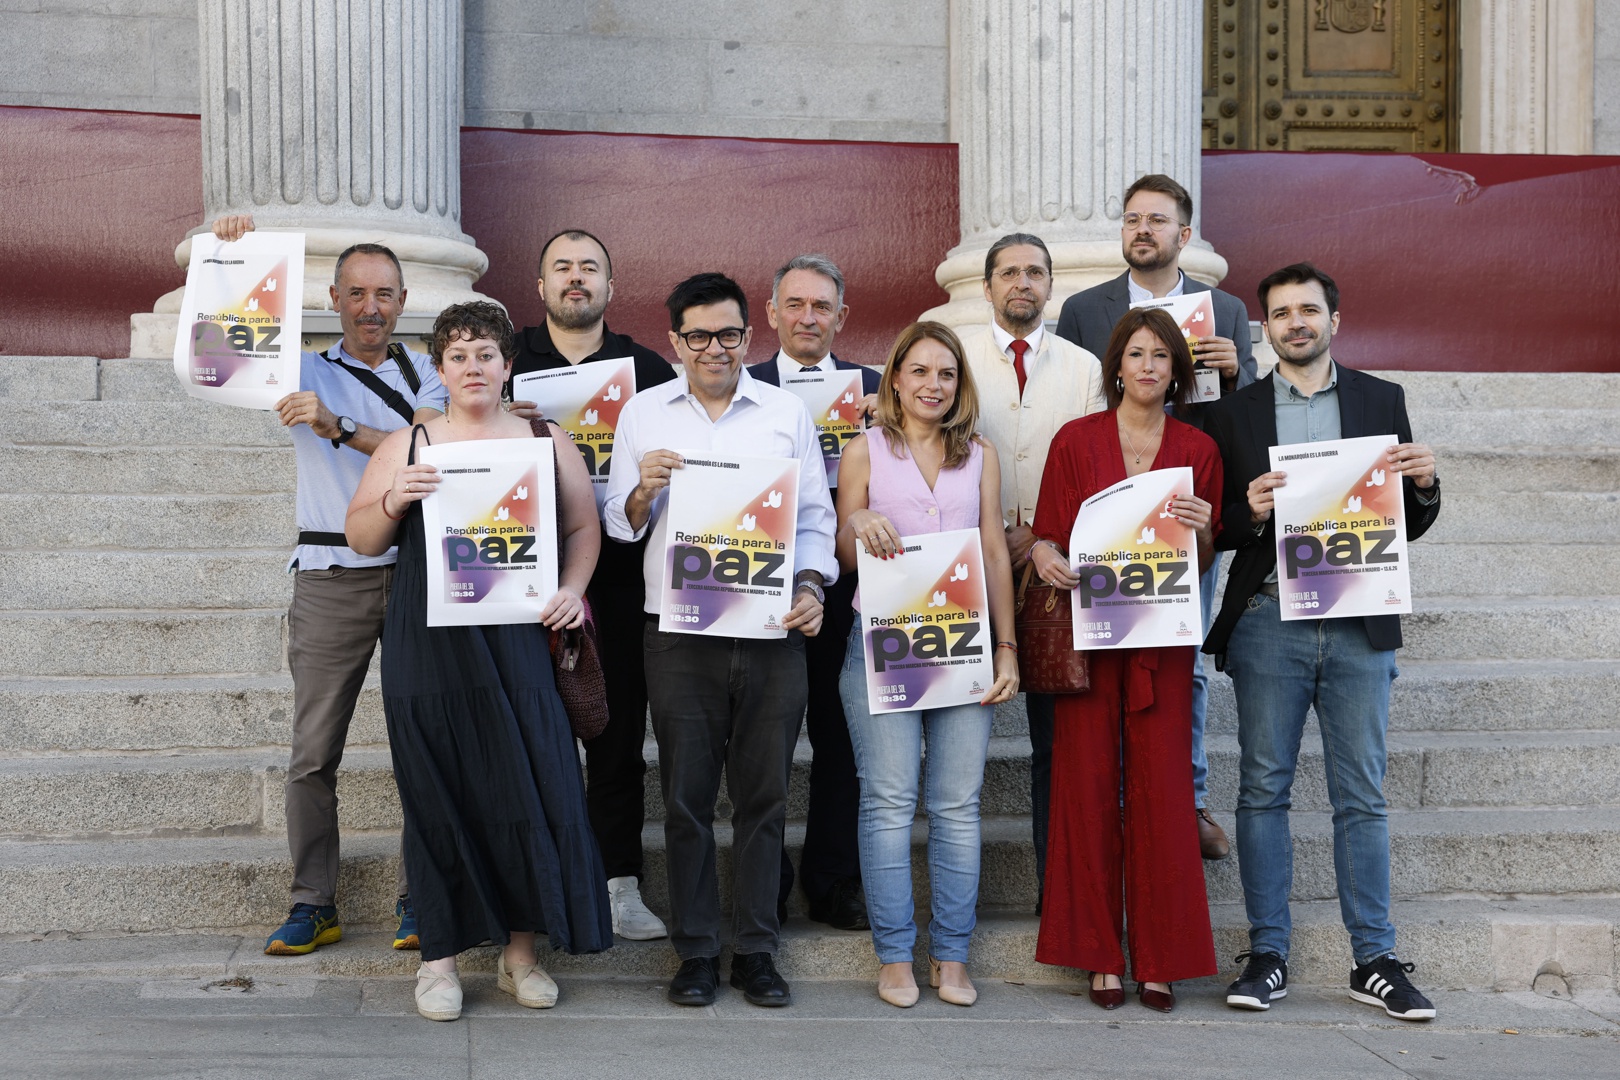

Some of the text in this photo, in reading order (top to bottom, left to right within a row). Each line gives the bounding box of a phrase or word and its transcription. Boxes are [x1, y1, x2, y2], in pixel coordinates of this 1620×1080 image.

[197, 313, 246, 323] República
[194, 322, 281, 356] paz
[587, 432, 614, 442] para
[1284, 452, 1309, 461] MONARQUÍA
[446, 526, 497, 536] República
[500, 526, 524, 534] para
[1284, 516, 1395, 534] República para la
[675, 531, 785, 549] República para la
[446, 536, 537, 571] paz
[1078, 548, 1188, 563] República para la
[1285, 529, 1399, 579] paz
[671, 545, 785, 590] paz
[1079, 562, 1191, 609] paz
[870, 609, 979, 626] República para la
[871, 622, 983, 672] paz
[878, 694, 906, 702] 18:30
